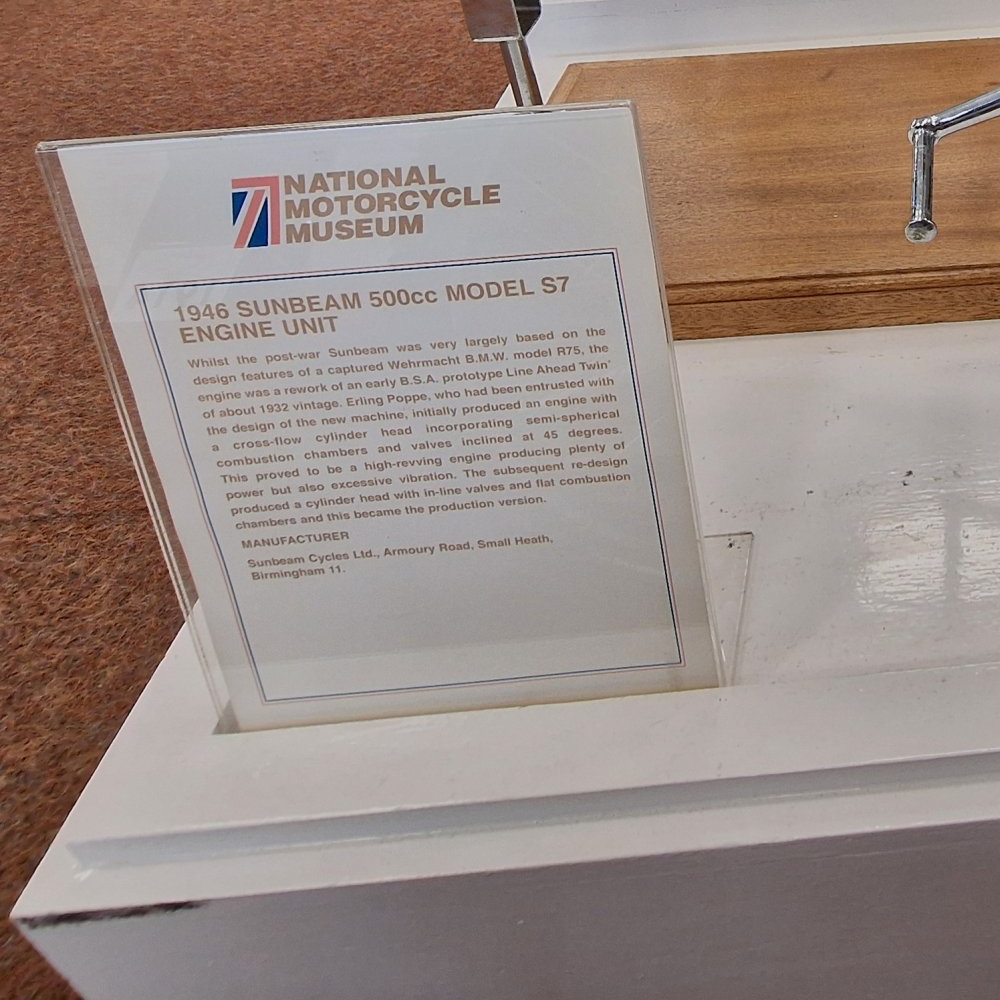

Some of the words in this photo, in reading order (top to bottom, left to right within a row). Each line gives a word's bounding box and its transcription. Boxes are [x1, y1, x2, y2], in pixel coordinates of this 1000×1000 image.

[283, 164, 446, 195] NATIONAL
[284, 184, 501, 220] MOTORCYCLE
[285, 214, 424, 244] MUSEUM
[173, 302, 230, 323] 1946
[235, 292, 362, 318] SUNBEAM
[368, 288, 439, 308] 500cc
[445, 278, 536, 302] MODEL
[540, 275, 570, 295] S7
[178, 320, 276, 344] ENGINE
[281, 315, 339, 336] UNIT
[186, 356, 230, 369] Whilst
[236, 355, 258, 365] the
[264, 351, 321, 365] post-war
[328, 346, 389, 358] Sunbeam
[396, 343, 423, 353] was
[429, 340, 457, 351] very
[464, 335, 508, 348] largely
[515, 330, 555, 343] based
[561, 330, 579, 340] on
[585, 327, 607, 338] the
[192, 374, 237, 386] design
[240, 370, 295, 382] features
[297, 366, 311, 377] of
[315, 368, 324, 376] a
[327, 361, 384, 376] captured
[387, 355, 461, 370] Wehrmacht
[464, 351, 509, 364] B.M.W.
[513, 347, 553, 360] model
[556, 345, 585, 357] R75,
[588, 344, 609, 354] the
[197, 390, 242, 403] engine
[244, 389, 271, 398] was
[273, 388, 282, 396] a
[284, 383, 329, 395] rework
[330, 381, 344, 392] of
[346, 382, 363, 390] an
[365, 377, 397, 389] early
[399, 374, 439, 386] B.S.A.
[442, 370, 504, 385] prototype
[505, 367, 534, 378] Line
[536, 362, 577, 375] Ahead
[202, 408, 216, 420] of
[218, 405, 257, 418] about
[259, 402, 290, 414] 1932
[292, 400, 343, 411] vintage.
[345, 396, 384, 407] Erling
[386, 393, 432, 405] Poppe,
[433, 389, 461, 400] who
[463, 386, 488, 398] had
[490, 385, 523, 395] been
[525, 378, 585, 393] entrusted
[587, 376, 615, 388] with
[206, 425, 228, 437] the
[231, 422, 276, 434] design
[279, 418, 292, 429] of
[295, 417, 317, 428] the
[320, 416, 347, 426] new
[350, 410, 409, 423] machine,
[411, 405, 457, 418] initially
[461, 400, 522, 417] produced
[525, 400, 541, 409] an
[544, 396, 588, 408] engine
[590, 393, 618, 404] with
[211, 444, 220, 452] a
[232, 436, 302, 450] cross-flow
[315, 430, 368, 445] cylinder
[380, 425, 413, 437] head
[425, 418, 513, 433] incorporating
[525, 408, 621, 425] semi-spherical
[216, 453, 295, 468] combustion
[303, 447, 369, 461] chambers
[377, 442, 402, 454] and
[410, 440, 453, 451] valves
[461, 433, 513, 447] inclined
[522, 432, 535, 442] at
[543, 430, 559, 440] 45
[567, 427, 623, 439] degrees.
[219, 473, 249, 484] This
[255, 467, 300, 483] proved
[306, 467, 320, 477] to
[326, 465, 343, 474] be
[349, 464, 358, 473] a
[363, 456, 443, 472] high-revving
[449, 452, 492, 465] engine
[498, 447, 562, 462] producing
[568, 443, 606, 456] plenty
[613, 440, 625, 451] of
[225, 489, 264, 502] power
[270, 485, 292, 496] but
[297, 483, 325, 493] also
[330, 476, 393, 490] excessive
[398, 471, 457, 484] vibration.
[462, 468, 487, 479] The
[492, 462, 565, 476] subsequent
[571, 457, 629, 469] re-design
[230, 500, 291, 517] produced
[293, 501, 302, 509] a
[305, 495, 356, 510] cylinder
[359, 491, 391, 503] head
[393, 489, 421, 500] with
[423, 487, 462, 498] in-line
[465, 483, 506, 494] valves
[508, 479, 532, 491] and
[535, 478, 556, 488] flat
[559, 472, 631, 487] combustion
[235, 517, 298, 530] chambers
[300, 513, 324, 524] and
[326, 511, 351, 522] this
[353, 508, 402, 519] became
[404, 505, 425, 515] the
[427, 499, 495, 515] production
[497, 495, 547, 507] version.
[240, 531, 350, 549] MANUFACTURER
[247, 556, 306, 569] Sunbeam
[308, 552, 350, 565] Cycles
[352, 548, 381, 560] Ltd.,
[383, 545, 435, 557] Armoury
[438, 540, 475, 553] Road,
[476, 537, 512, 549] Small
[514, 534, 554, 546] Heath,
[250, 567, 326, 581] Birmingham
[328, 564, 346, 574] 11.
